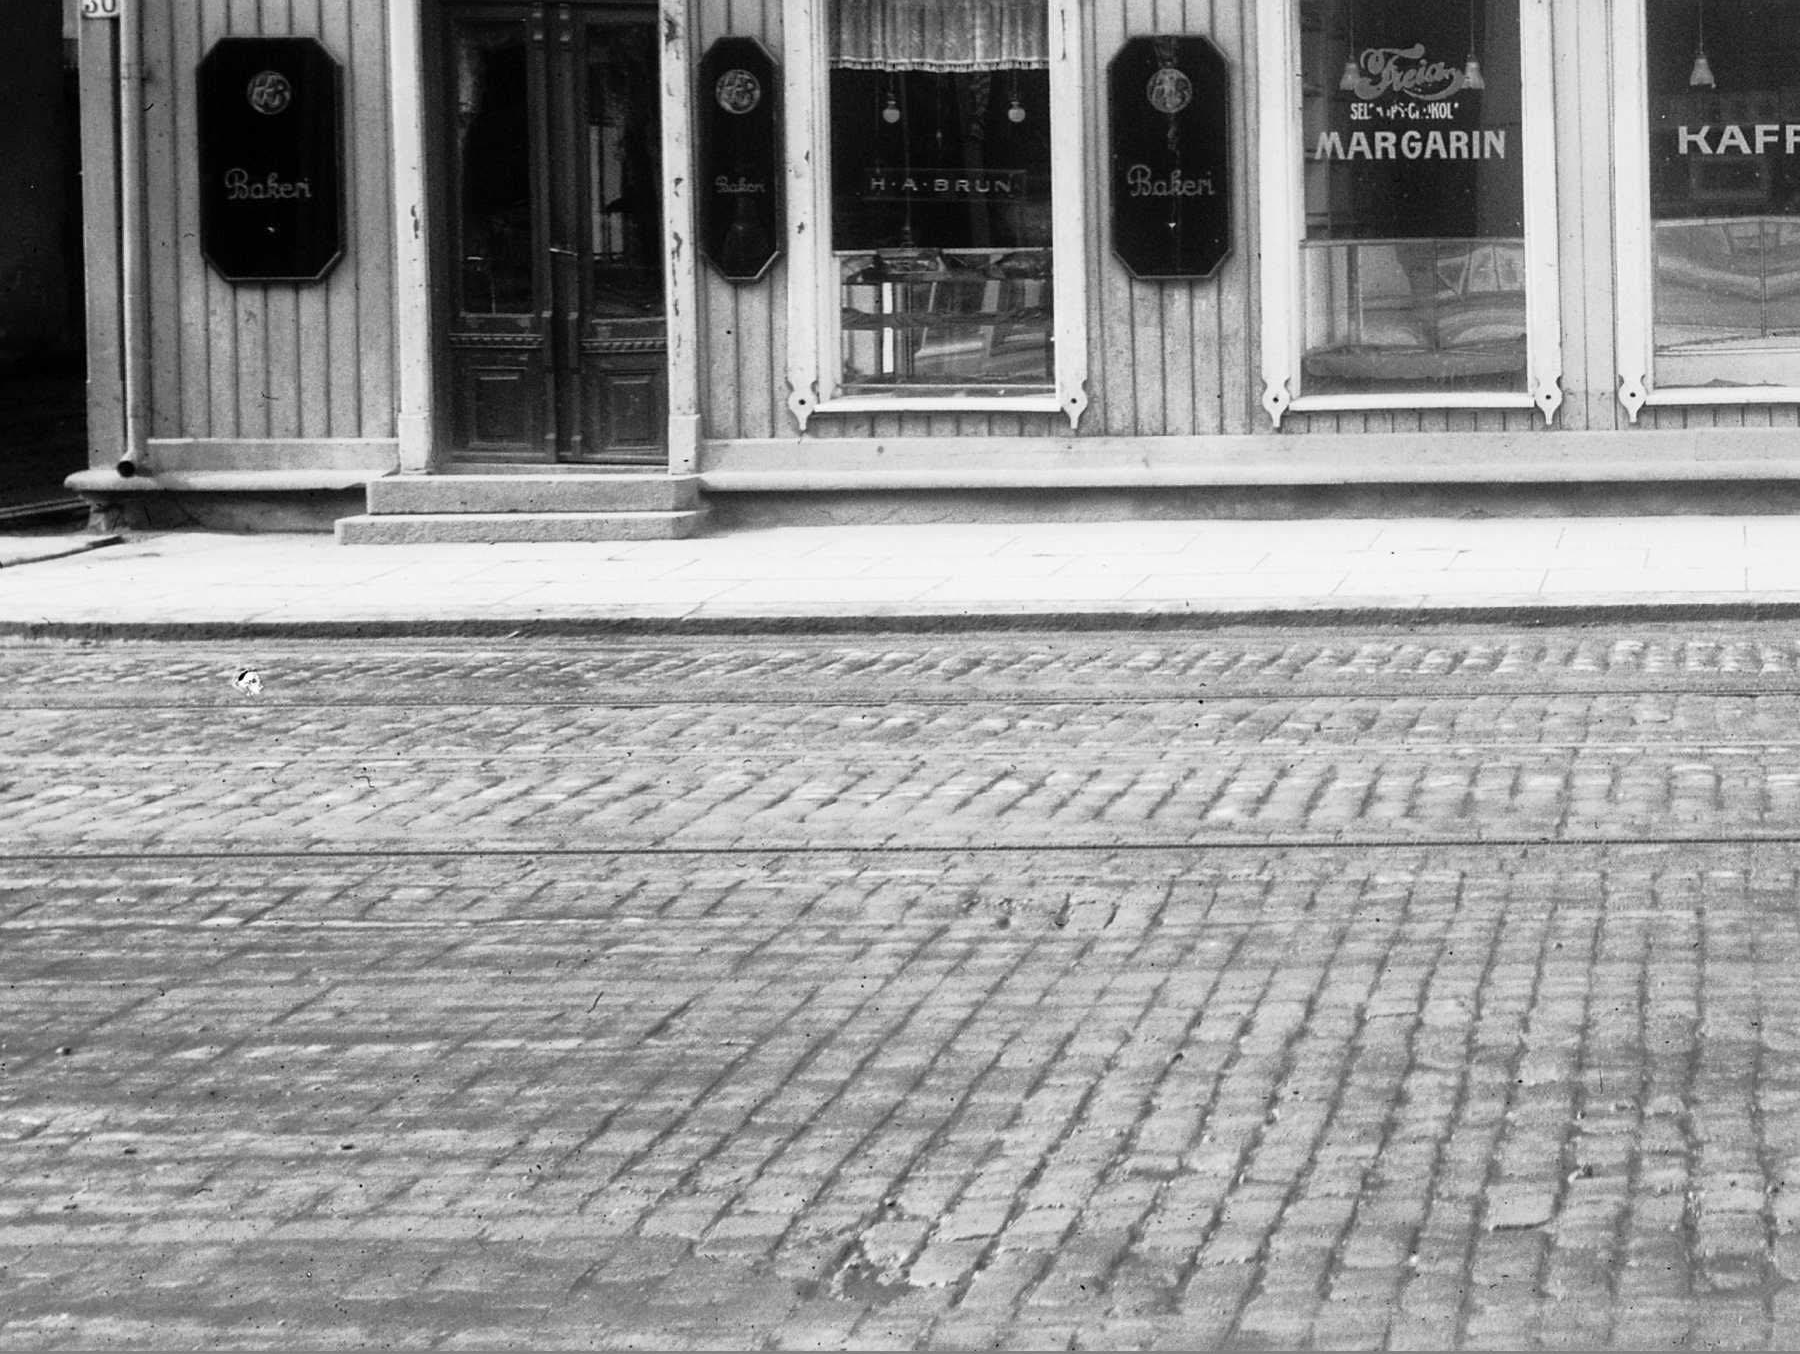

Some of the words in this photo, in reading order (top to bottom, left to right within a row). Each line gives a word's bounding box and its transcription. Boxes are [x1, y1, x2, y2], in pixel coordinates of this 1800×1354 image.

[1352, 42, 1467, 100] Freia
[1314, 129, 1506, 160] MARGARIN
[224, 167, 313, 200] Bakeri
[1126, 164, 1216, 197] Bakeri
